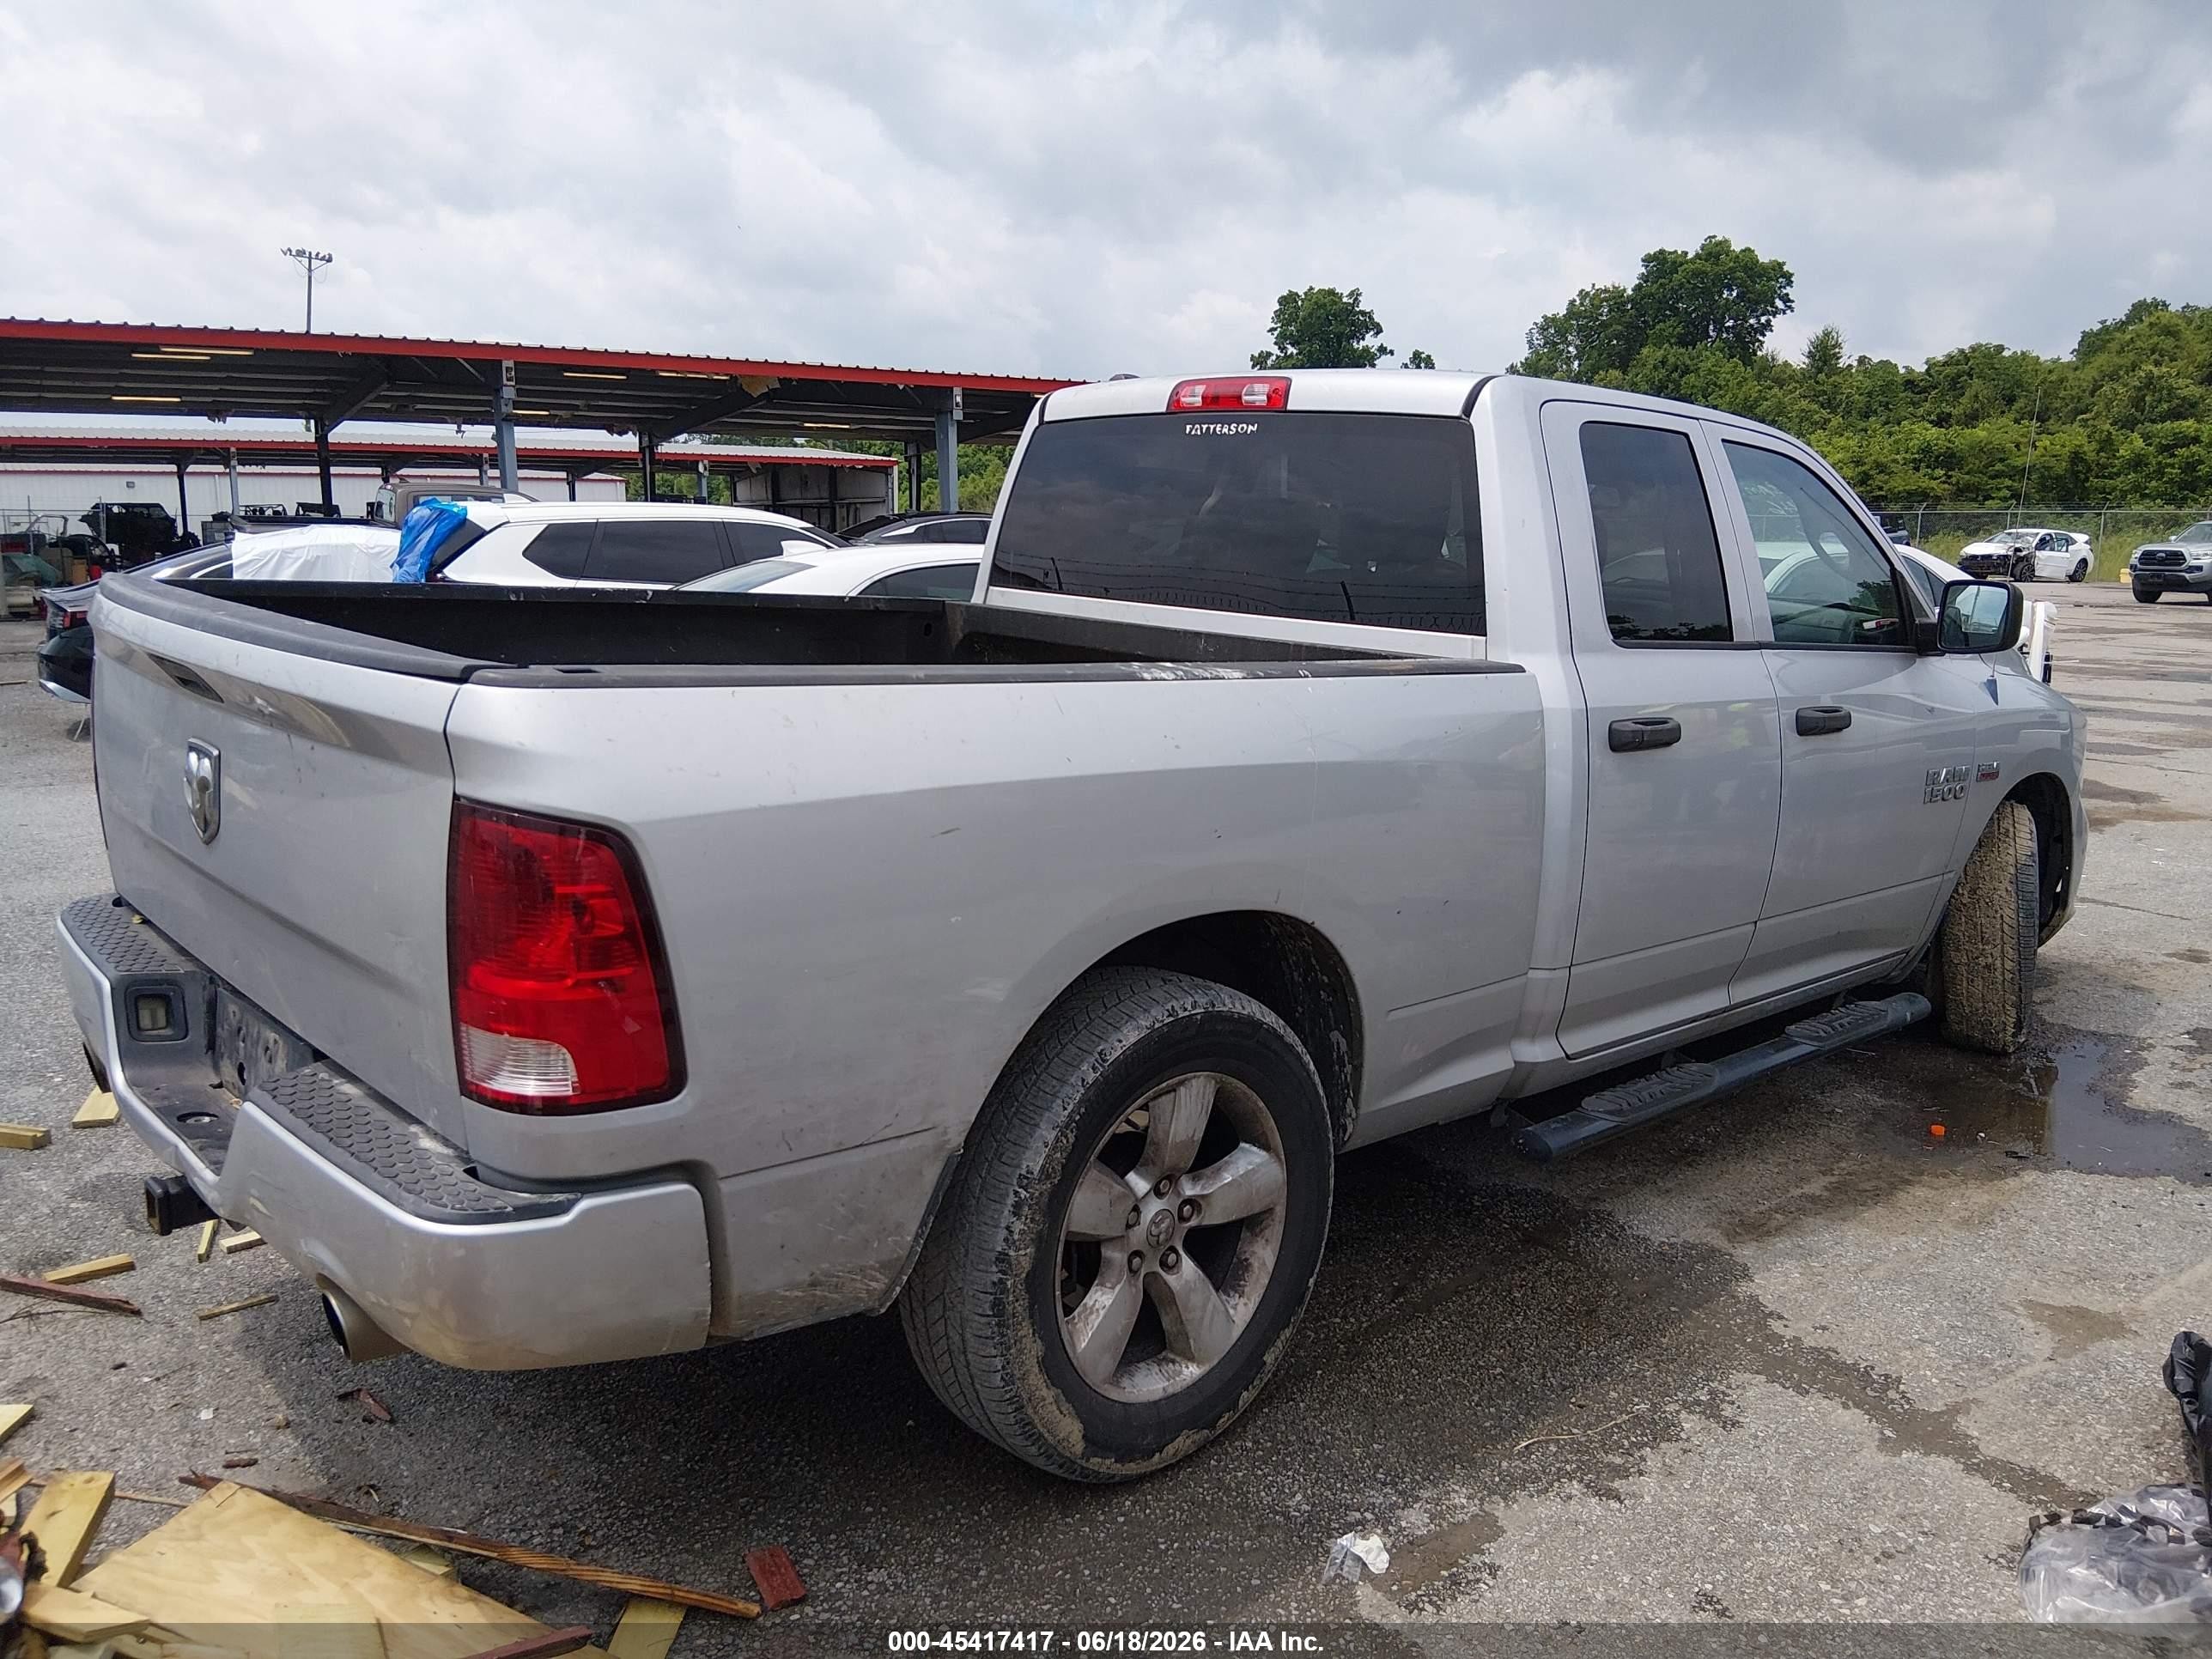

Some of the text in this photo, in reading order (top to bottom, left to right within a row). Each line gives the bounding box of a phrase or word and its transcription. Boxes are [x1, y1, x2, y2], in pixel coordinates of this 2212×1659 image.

[1185, 422, 1258, 435] PATTERSON
[1925, 765, 1971, 786] RAM
[1923, 783, 1966, 804] 1500
